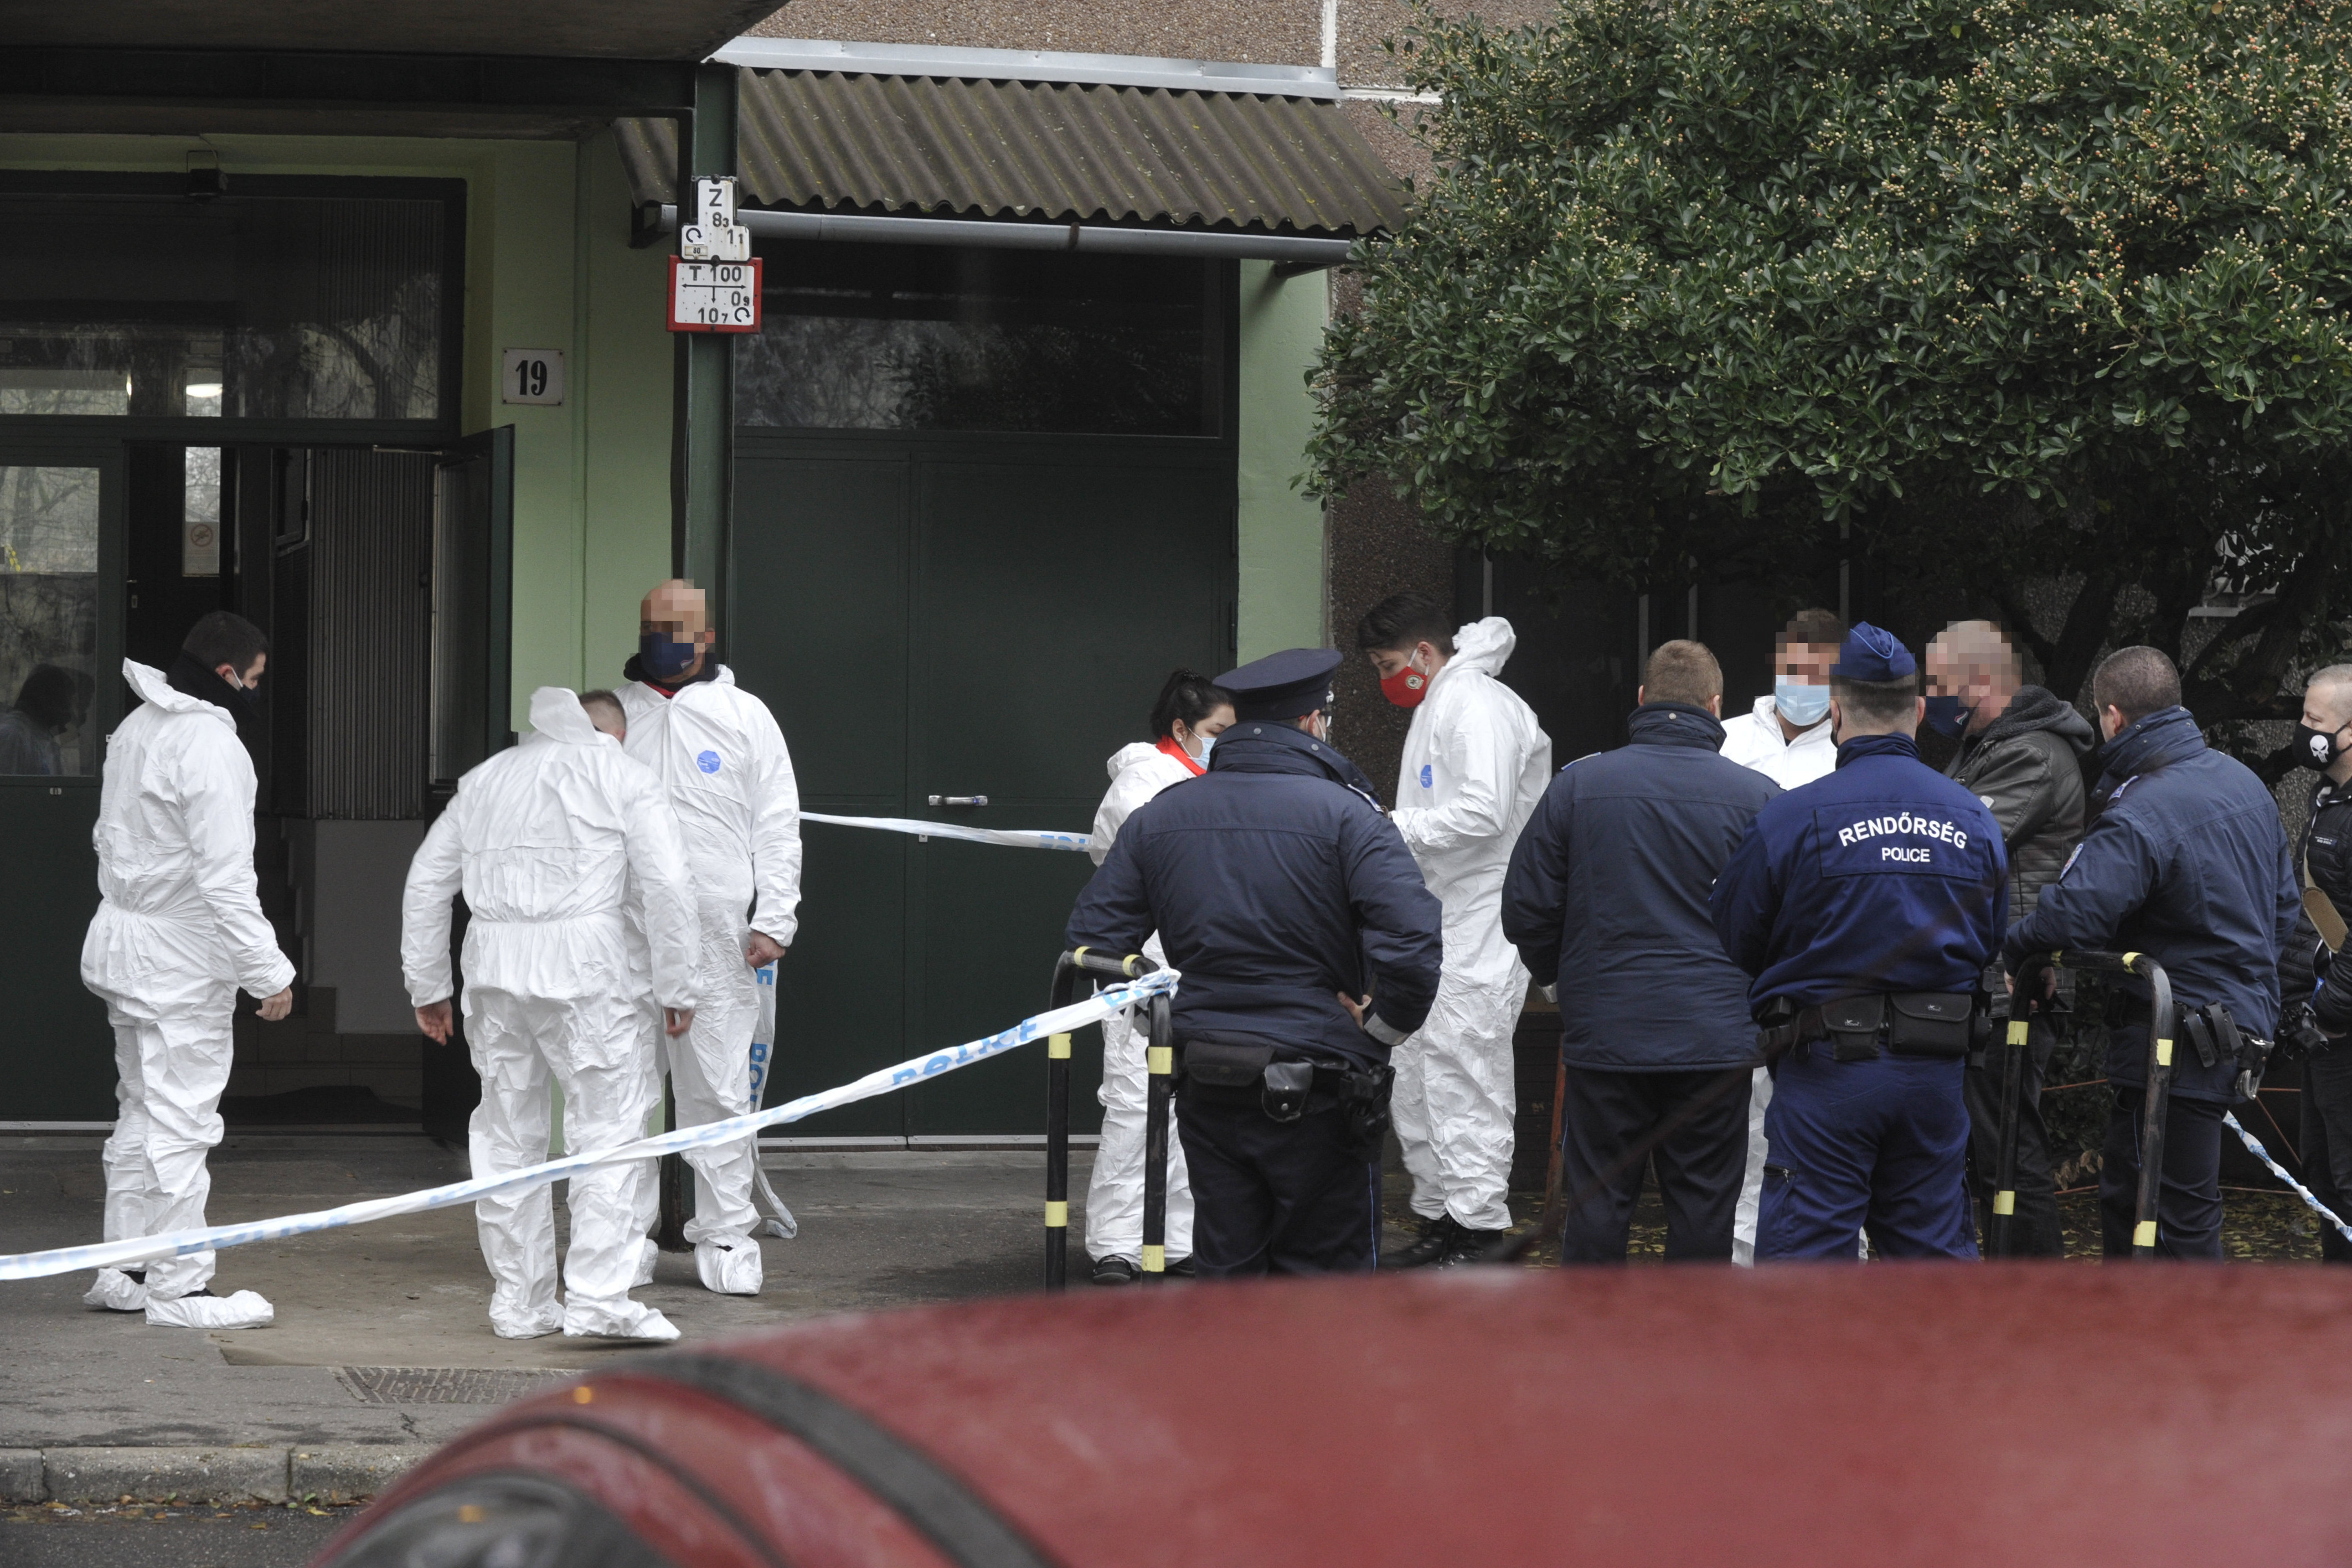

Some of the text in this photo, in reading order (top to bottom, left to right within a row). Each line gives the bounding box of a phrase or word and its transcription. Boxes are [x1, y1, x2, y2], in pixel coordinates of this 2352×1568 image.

[709, 188, 722, 207] Z
[515, 360, 547, 396] 19
[1838, 812, 1967, 849] RENDŐRSÉG
[1881, 847, 1931, 863] POLICE
